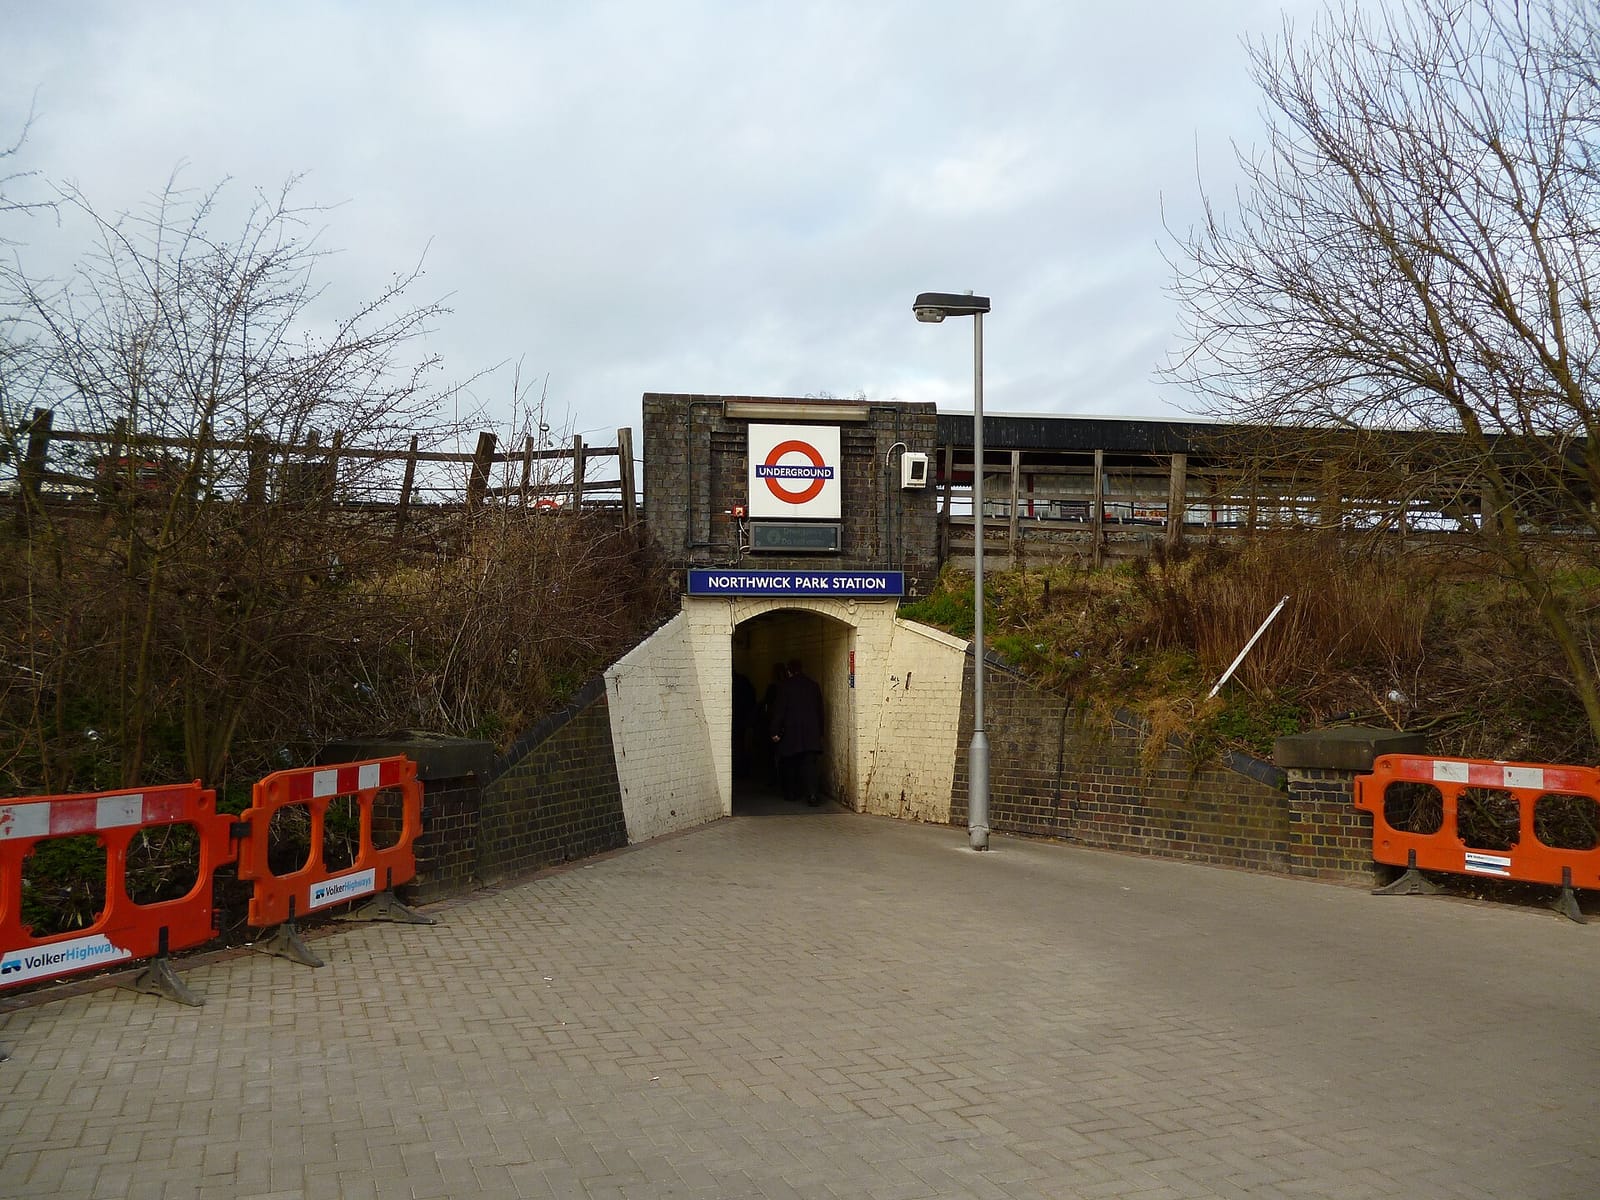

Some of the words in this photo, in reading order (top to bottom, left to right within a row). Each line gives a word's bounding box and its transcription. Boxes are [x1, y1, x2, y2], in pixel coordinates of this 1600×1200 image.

[759, 467, 832, 477] UNDERGROUND
[708, 577, 791, 588] NORTHWICK
[795, 577, 828, 589] PARK
[832, 578, 886, 589] STATION
[325, 877, 371, 897] VolkerHighways
[24, 942, 116, 969] VolkerHighway
